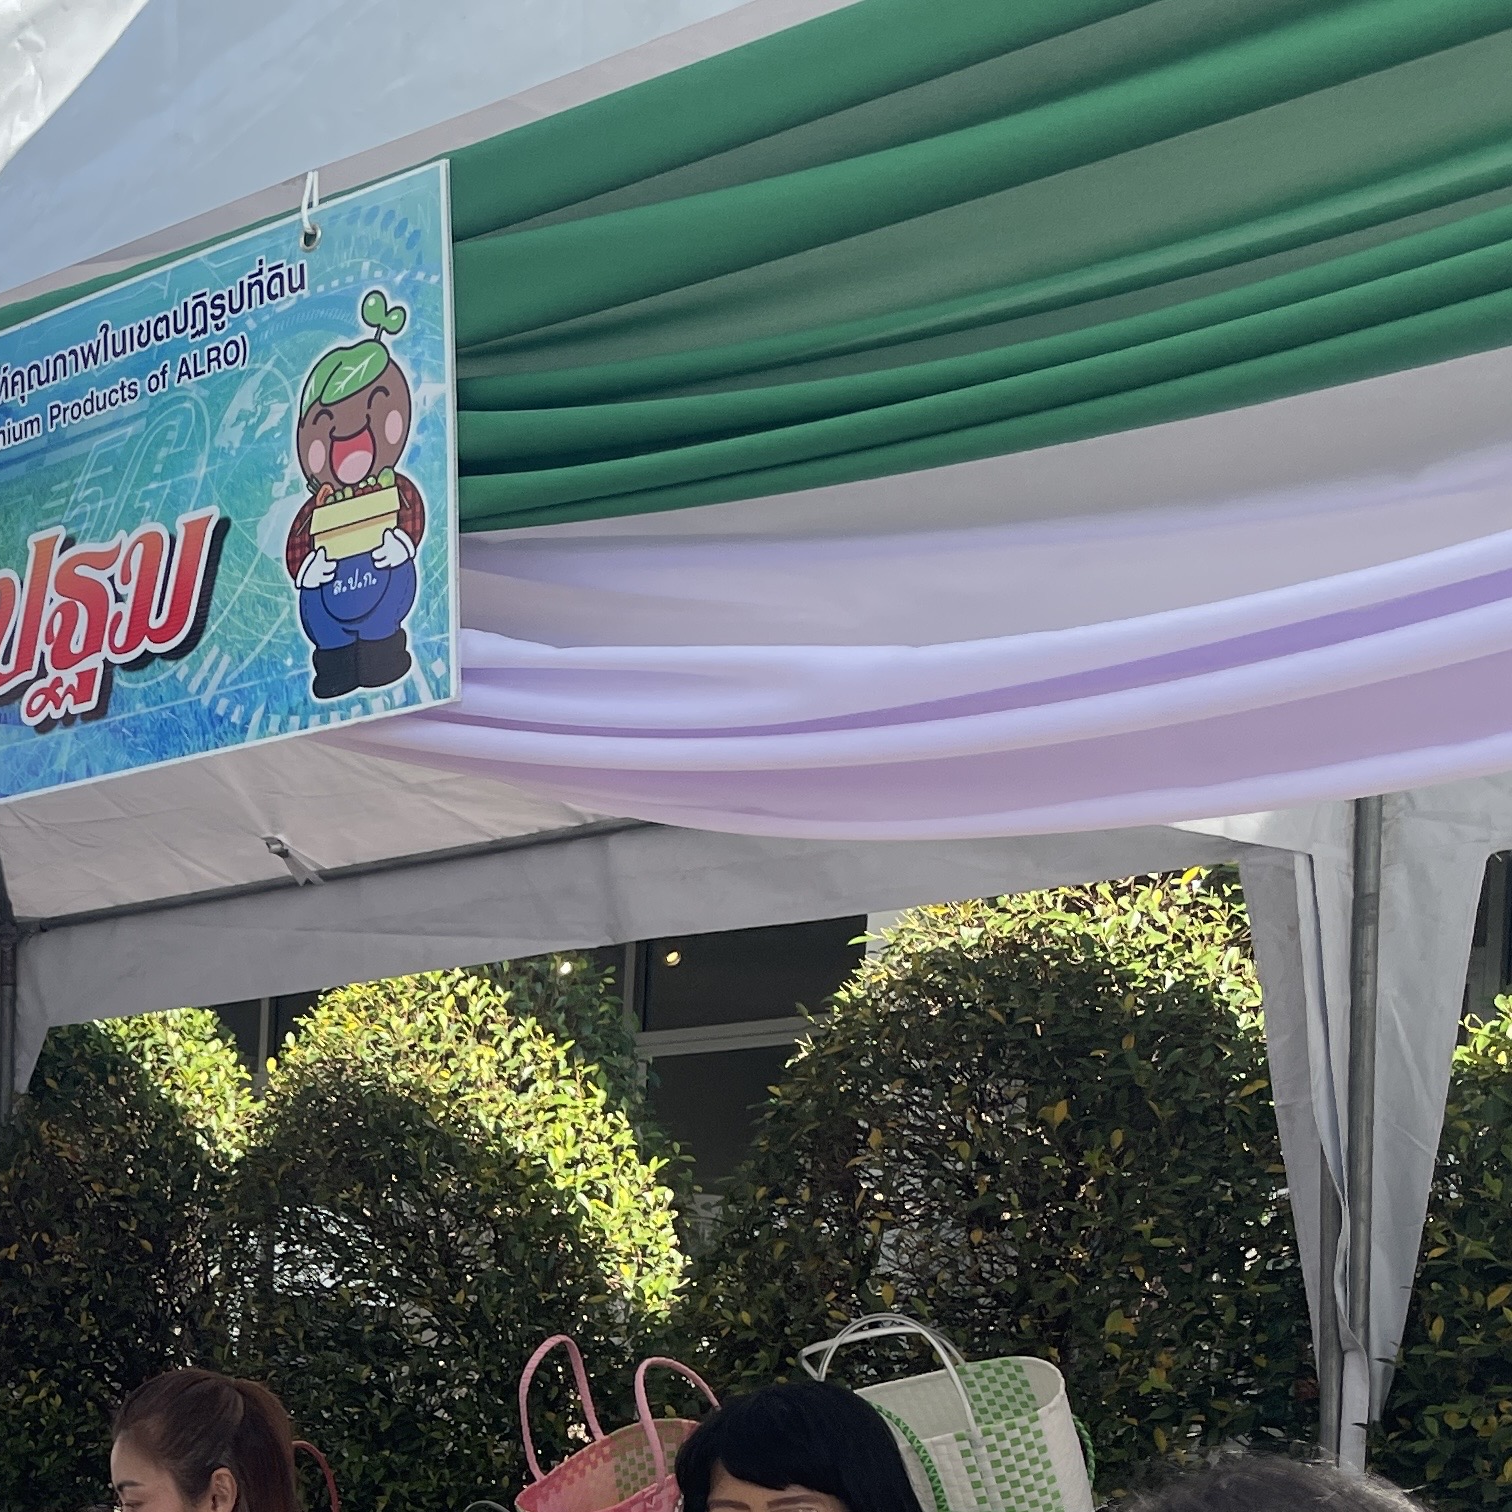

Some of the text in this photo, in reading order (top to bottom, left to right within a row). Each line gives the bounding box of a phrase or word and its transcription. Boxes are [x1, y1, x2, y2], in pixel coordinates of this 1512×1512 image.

[48, 376, 139, 432] Products
[146, 364, 172, 396] of
[176, 333, 249, 385] ALRO)
[332, 567, 378, 597] ส.ป.ก.
